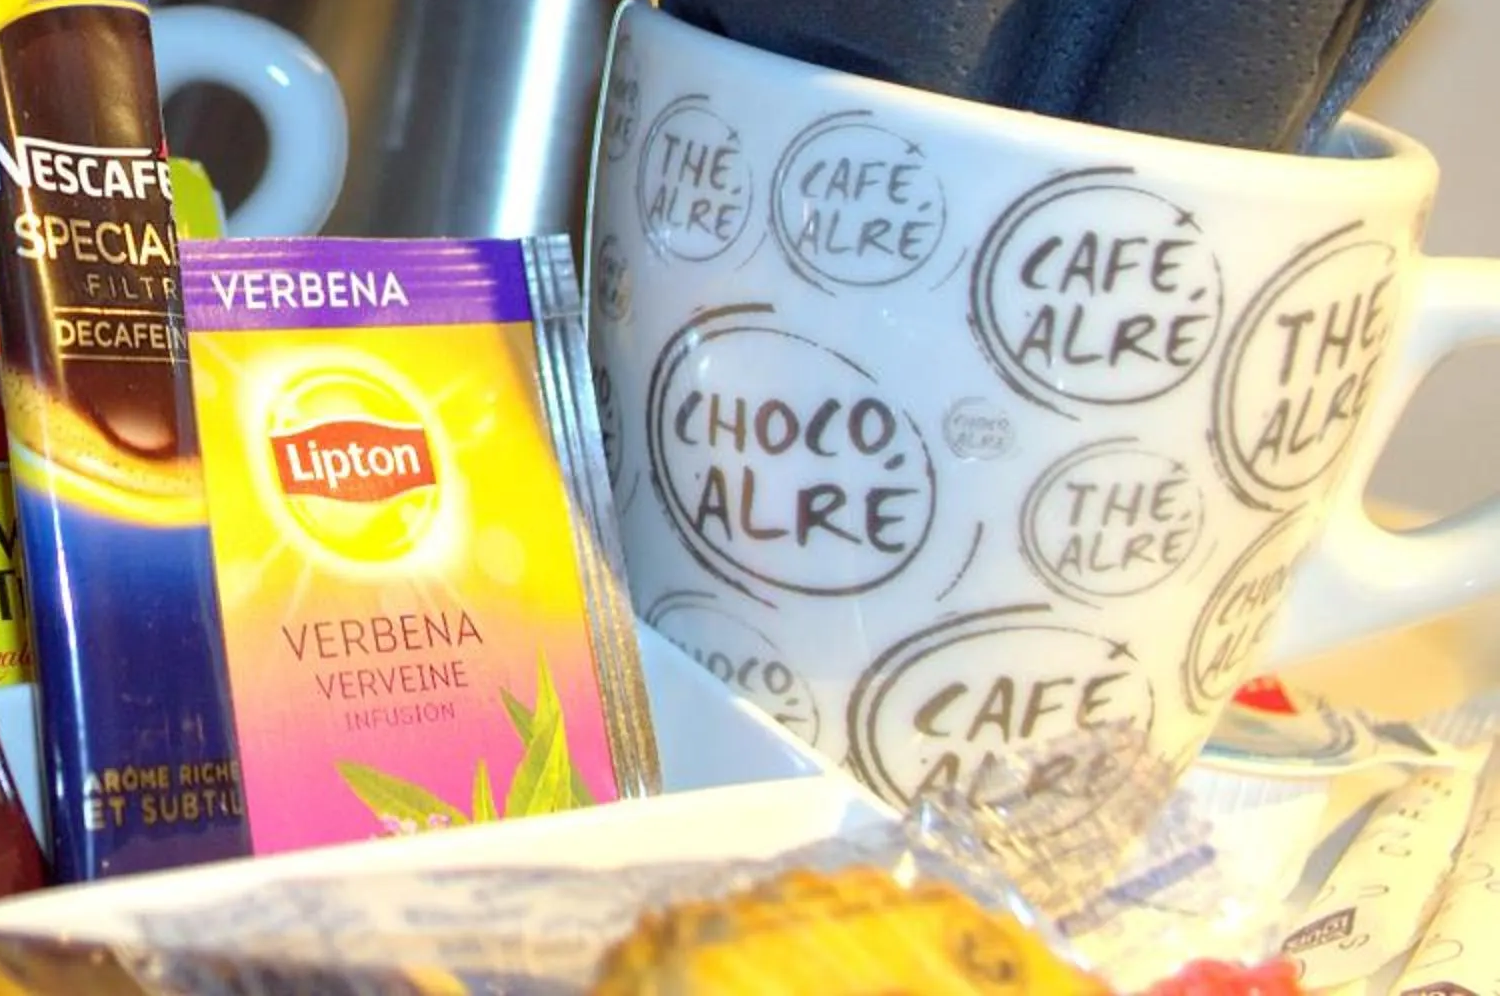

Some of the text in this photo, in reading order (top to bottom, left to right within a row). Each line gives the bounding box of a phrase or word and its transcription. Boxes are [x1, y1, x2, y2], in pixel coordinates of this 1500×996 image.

[211, 270, 410, 313] VERBENA
[285, 441, 422, 491] Lipton
[280, 609, 484, 663] VERBENA
[315, 660, 471, 701] VERVEINE
[344, 701, 457, 733] INFUSION
[179, 760, 240, 786] RICHE
[83, 797, 125, 832] ET
